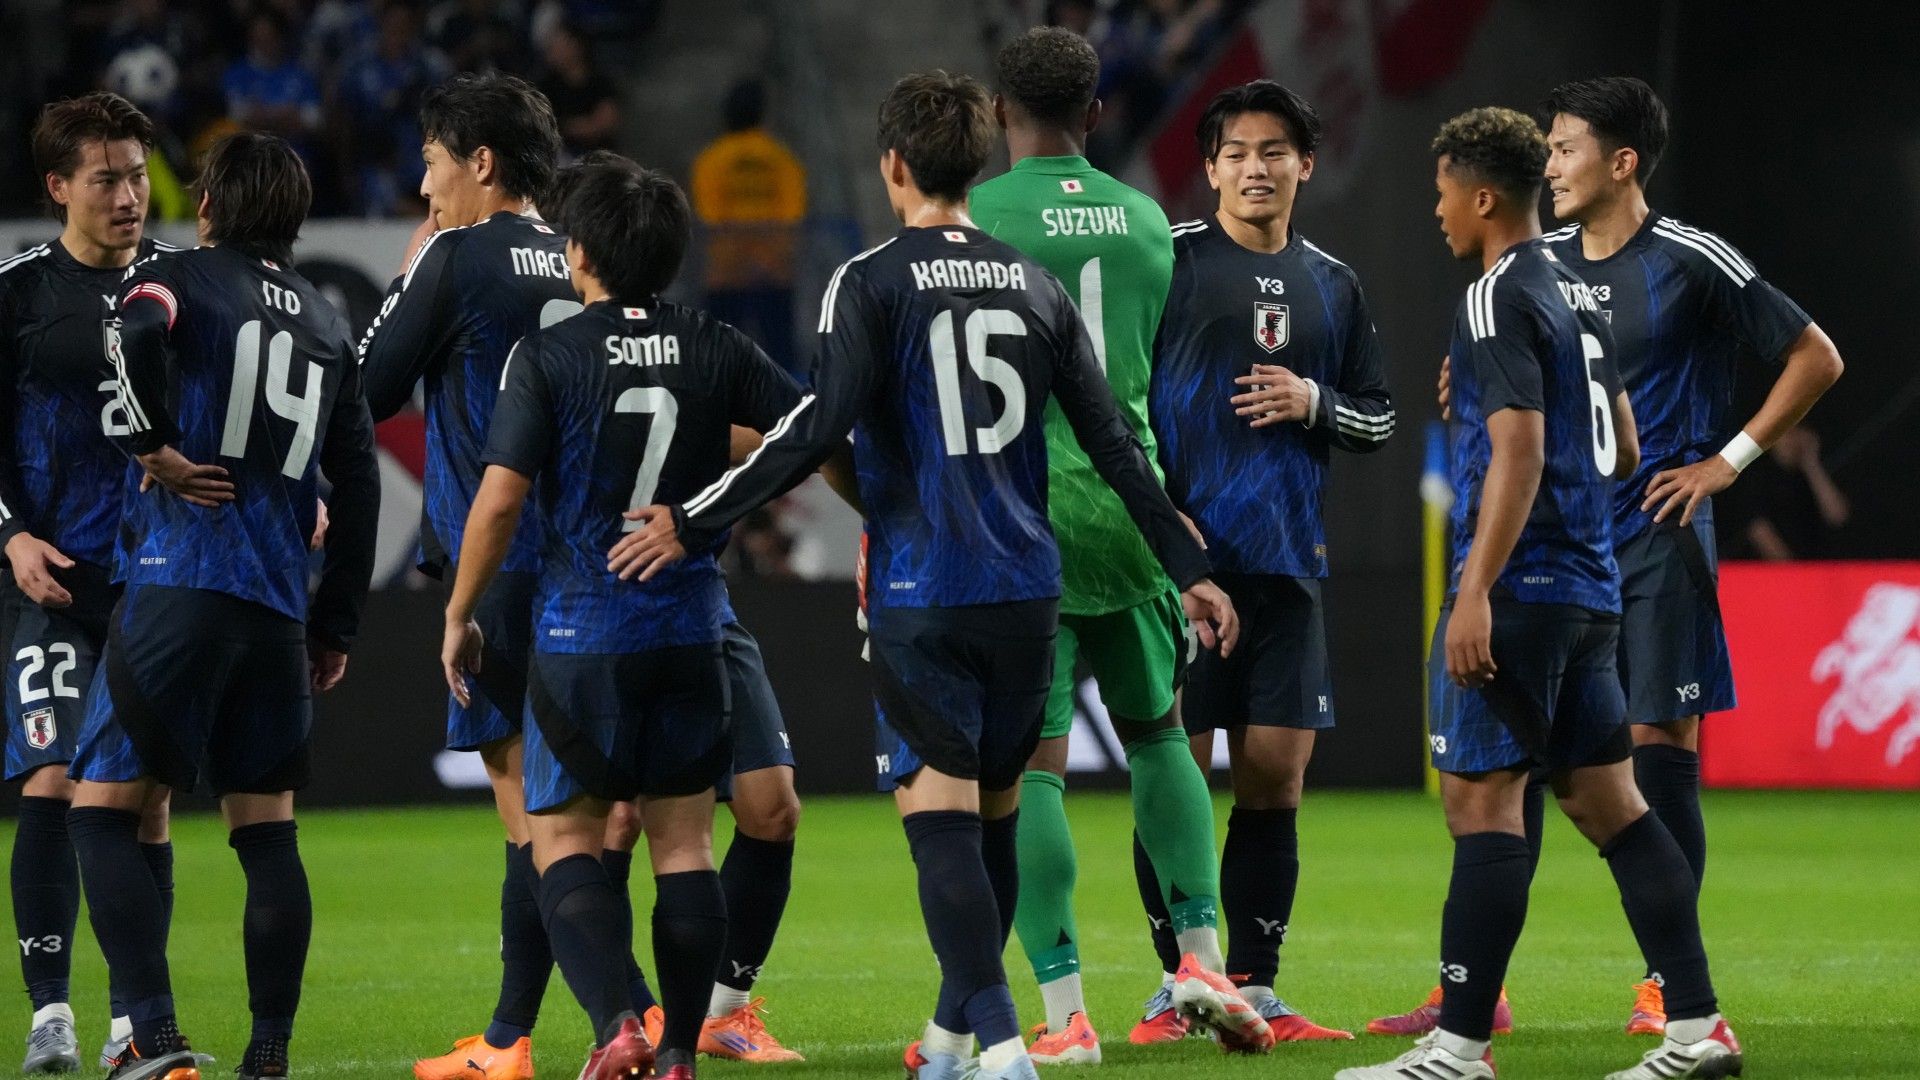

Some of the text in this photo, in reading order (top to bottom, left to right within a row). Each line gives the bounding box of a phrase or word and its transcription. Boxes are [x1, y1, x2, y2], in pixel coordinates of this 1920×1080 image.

[1041, 206, 1128, 237] SUZUKI
[910, 259, 1027, 291] KAMADA
[1255, 276, 1285, 295] Y-3
[262, 280, 301, 315] ITO
[1080, 257, 1107, 377] 1
[605, 334, 680, 366] SOMA
[220, 319, 324, 480] 14
[929, 309, 1028, 456] 15
[1580, 333, 1617, 477] 6
[615, 386, 679, 533] 7
[15, 642, 79, 704] 22
[1675, 682, 1700, 702] Y-3
[19, 934, 62, 956] Y-3
